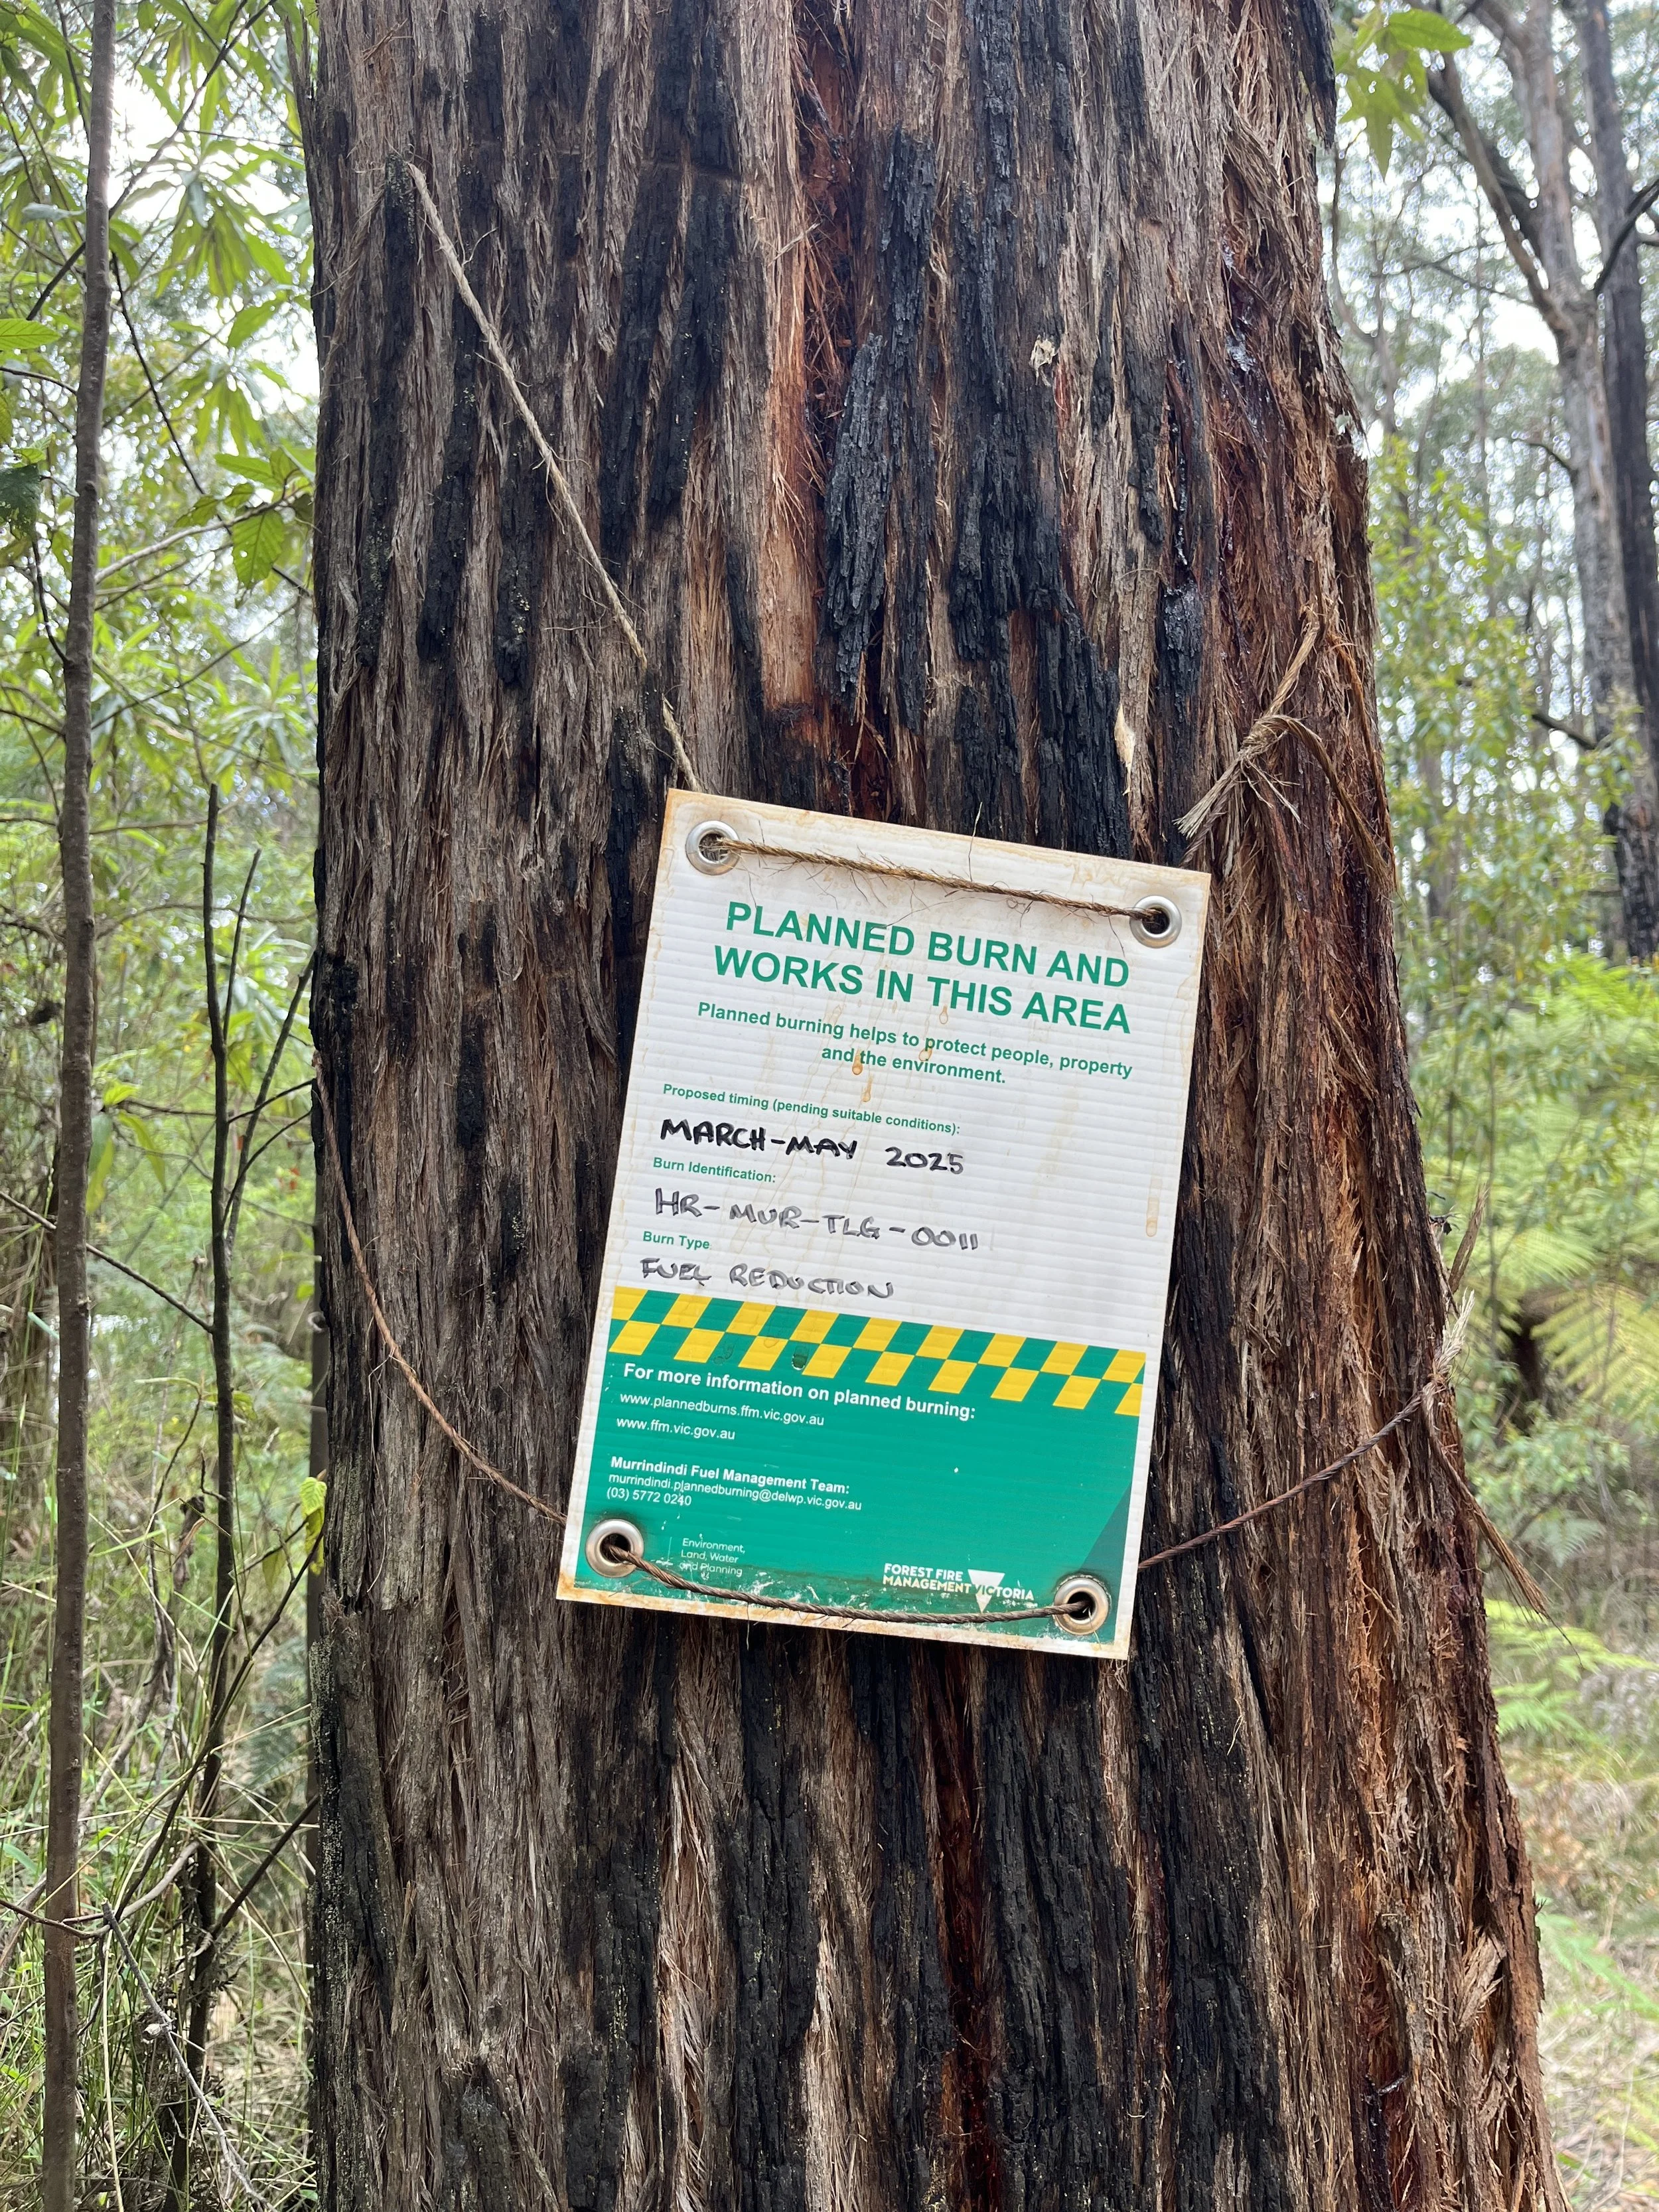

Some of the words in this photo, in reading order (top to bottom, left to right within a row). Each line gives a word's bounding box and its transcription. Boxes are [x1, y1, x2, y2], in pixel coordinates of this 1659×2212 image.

[727, 901, 914, 956] PLANNED
[928, 932, 1036, 974] BURN
[1046, 950, 1129, 987] AND
[715, 945, 863, 995] WORKS
[876, 970, 913, 1002] IN
[928, 976, 1012, 1015] THIS
[1022, 992, 1131, 1033] AREA
[698, 1001, 770, 1025] Planned
[776, 1013, 844, 1039] burning
[850, 1024, 897, 1045] helps
[902, 1032, 919, 1047] to
[925, 1037, 987, 1057] protect
[991, 1045, 1054, 1068] people,
[1059, 1056, 1133, 1080] property
[822, 1047, 855, 1063] and
[860, 1050, 887, 1067] the
[892, 1057, 1005, 1084] environment.
[663, 1084, 725, 1102] Proposed
[729, 1092, 769, 1110] timing
[772, 1098, 828, 1119] (pending
[831, 1107, 882, 1124] suitable
[885, 1115, 961, 1136] conditions):
[660, 1119, 857, 1159] MARCH-MAY
[885, 1147, 964, 1175] 2025
[653, 1157, 685, 1172] Burn
[688, 1161, 776, 1183] Identification:
[643, 1230, 674, 1245] Burn
[640, 1258, 712, 1281] FUEL
[729, 1263, 894, 1299] REDUCTION
[624, 1363, 654, 1379] For
[658, 1370, 701, 1386] more
[706, 1372, 804, 1397] information
[808, 1386, 829, 1400] on
[833, 1388, 901, 1410] planned
[906, 1397, 975, 1421] burning:
[620, 1394, 825, 1426] www.plannedburns.ffm.vic.gov.au
[616, 1418, 735, 1440] www.ffm.vic.gov.au
[609, 1473, 862, 1511] murrindindi.plannedburning@delwp.vic.gov.au
[611, 1456, 687, 1475] Murrindindi
[691, 1465, 719, 1479] Fuel
[723, 1469, 807, 1490] Management
[810, 1479, 849, 1494] Team:
[607, 1487, 629, 1501] (03)
[632, 1489, 660, 1503] 5772
[663, 1493, 691, 1506] 0240
[681, 1550, 707, 1561] Land,
[710, 1553, 739, 1563] Water
[682, 1538, 745, 1554] Environment,
[680, 1562, 698, 1571] and
[700, 1562, 743, 1578] Planning
[884, 1562, 933, 1578] FOREST
[935, 1568, 963, 1582] FIRE
[883, 1574, 972, 1593] MANAGEMENT
[974, 1584, 1035, 1601] VICTORIA
